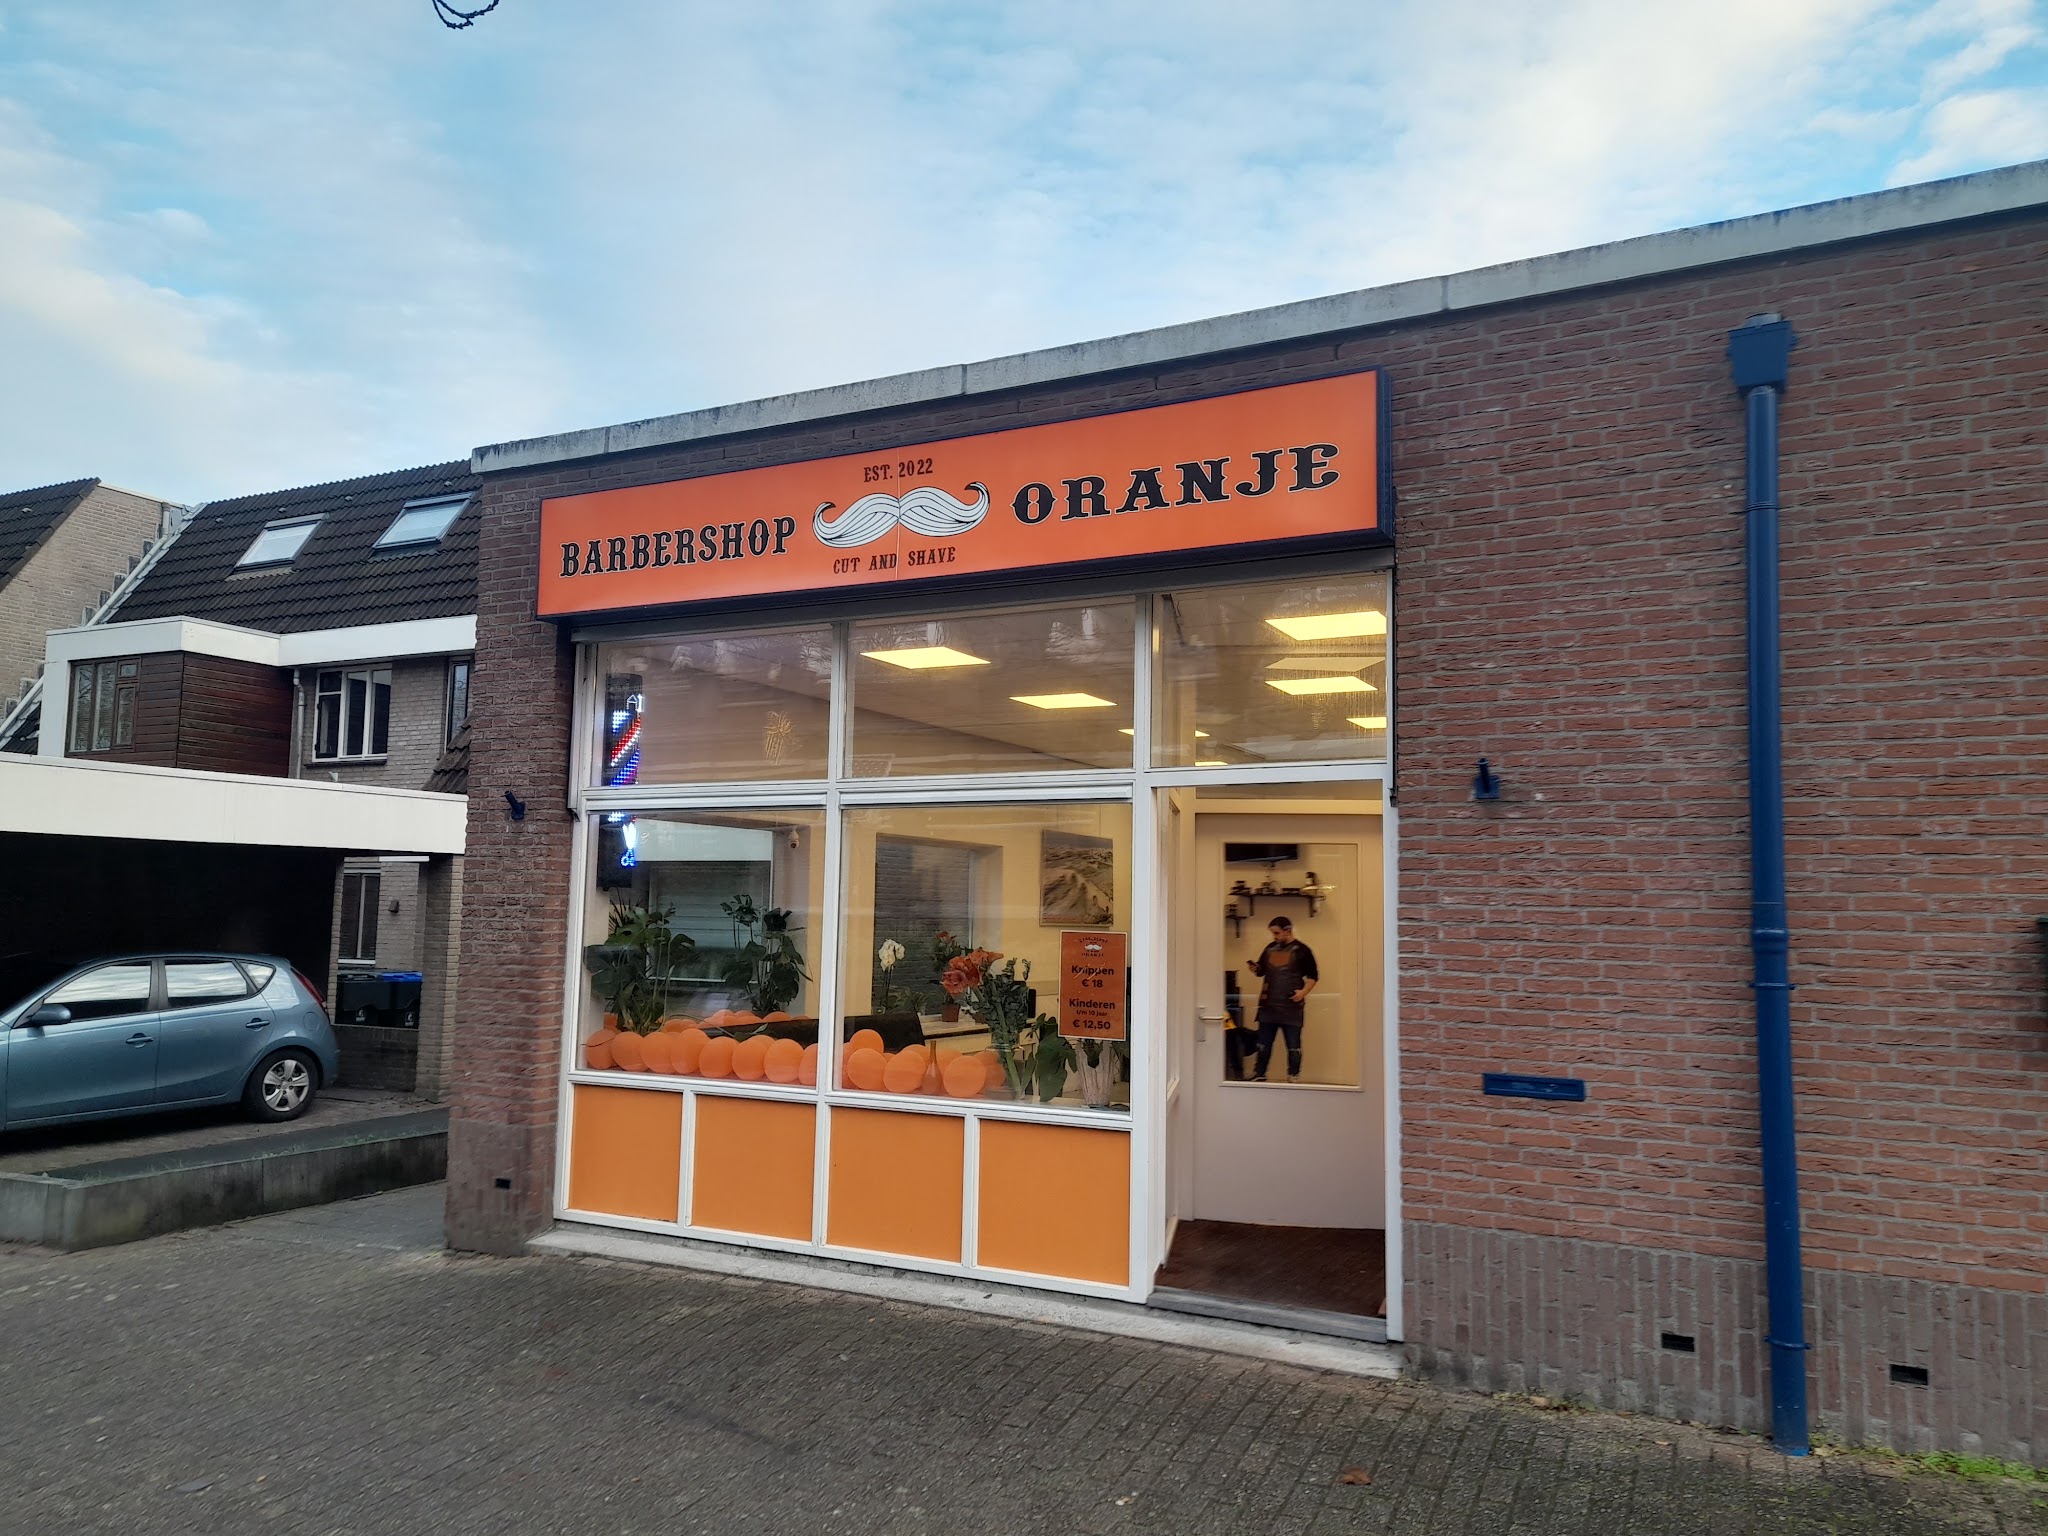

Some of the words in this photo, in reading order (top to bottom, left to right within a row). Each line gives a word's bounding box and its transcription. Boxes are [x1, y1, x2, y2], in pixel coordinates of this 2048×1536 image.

[863, 464, 893, 483] EST.
[898, 458, 933, 478] 2022
[559, 515, 796, 578] BARBERSHOP
[1010, 442, 1341, 525] ORANJE
[833, 557, 861, 574] CUT
[868, 553, 897, 571] AND
[908, 546, 956, 567] SHAVE
[1071, 965, 1115, 976] Knippen
[1081, 979, 1089, 988] €
[1093, 979, 1103, 988] 18
[1069, 998, 1116, 1010] Kinderen
[1072, 1019, 1080, 1028] €
[1083, 1020, 1111, 1030] 12,50
